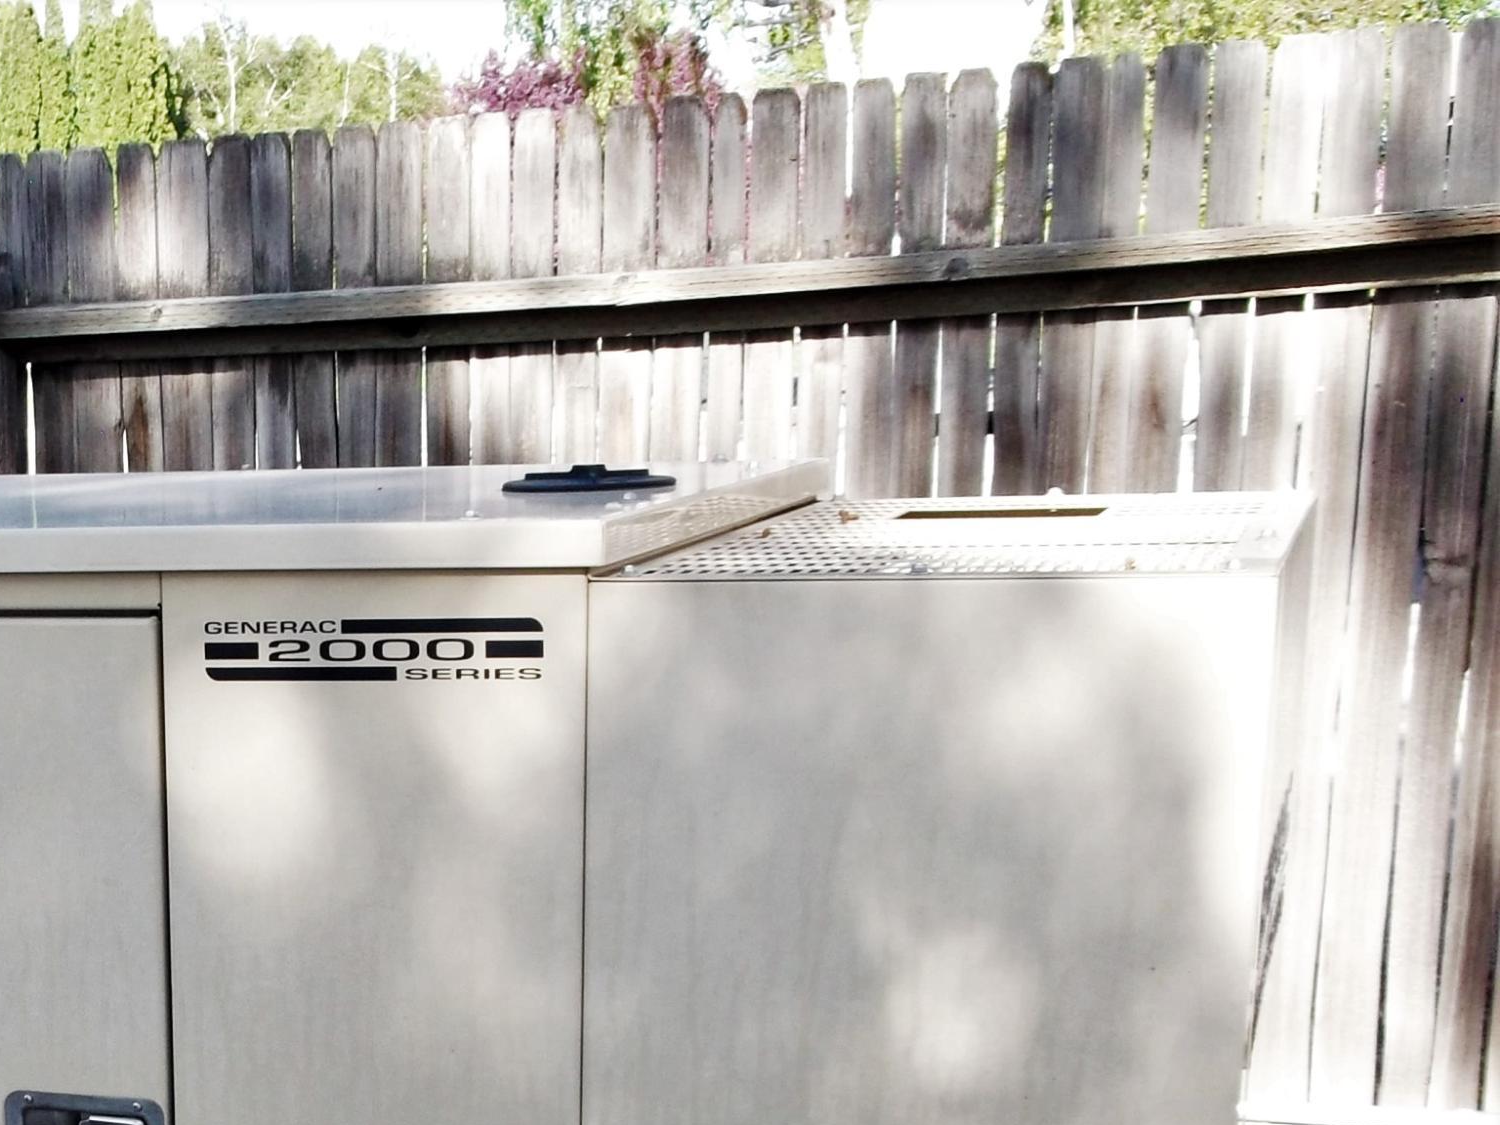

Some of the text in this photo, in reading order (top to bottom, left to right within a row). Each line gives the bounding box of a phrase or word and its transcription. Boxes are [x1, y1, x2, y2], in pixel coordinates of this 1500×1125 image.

[204, 620, 337, 635] GENERAC
[268, 638, 475, 662] 2000
[404, 668, 543, 681] SERIES
